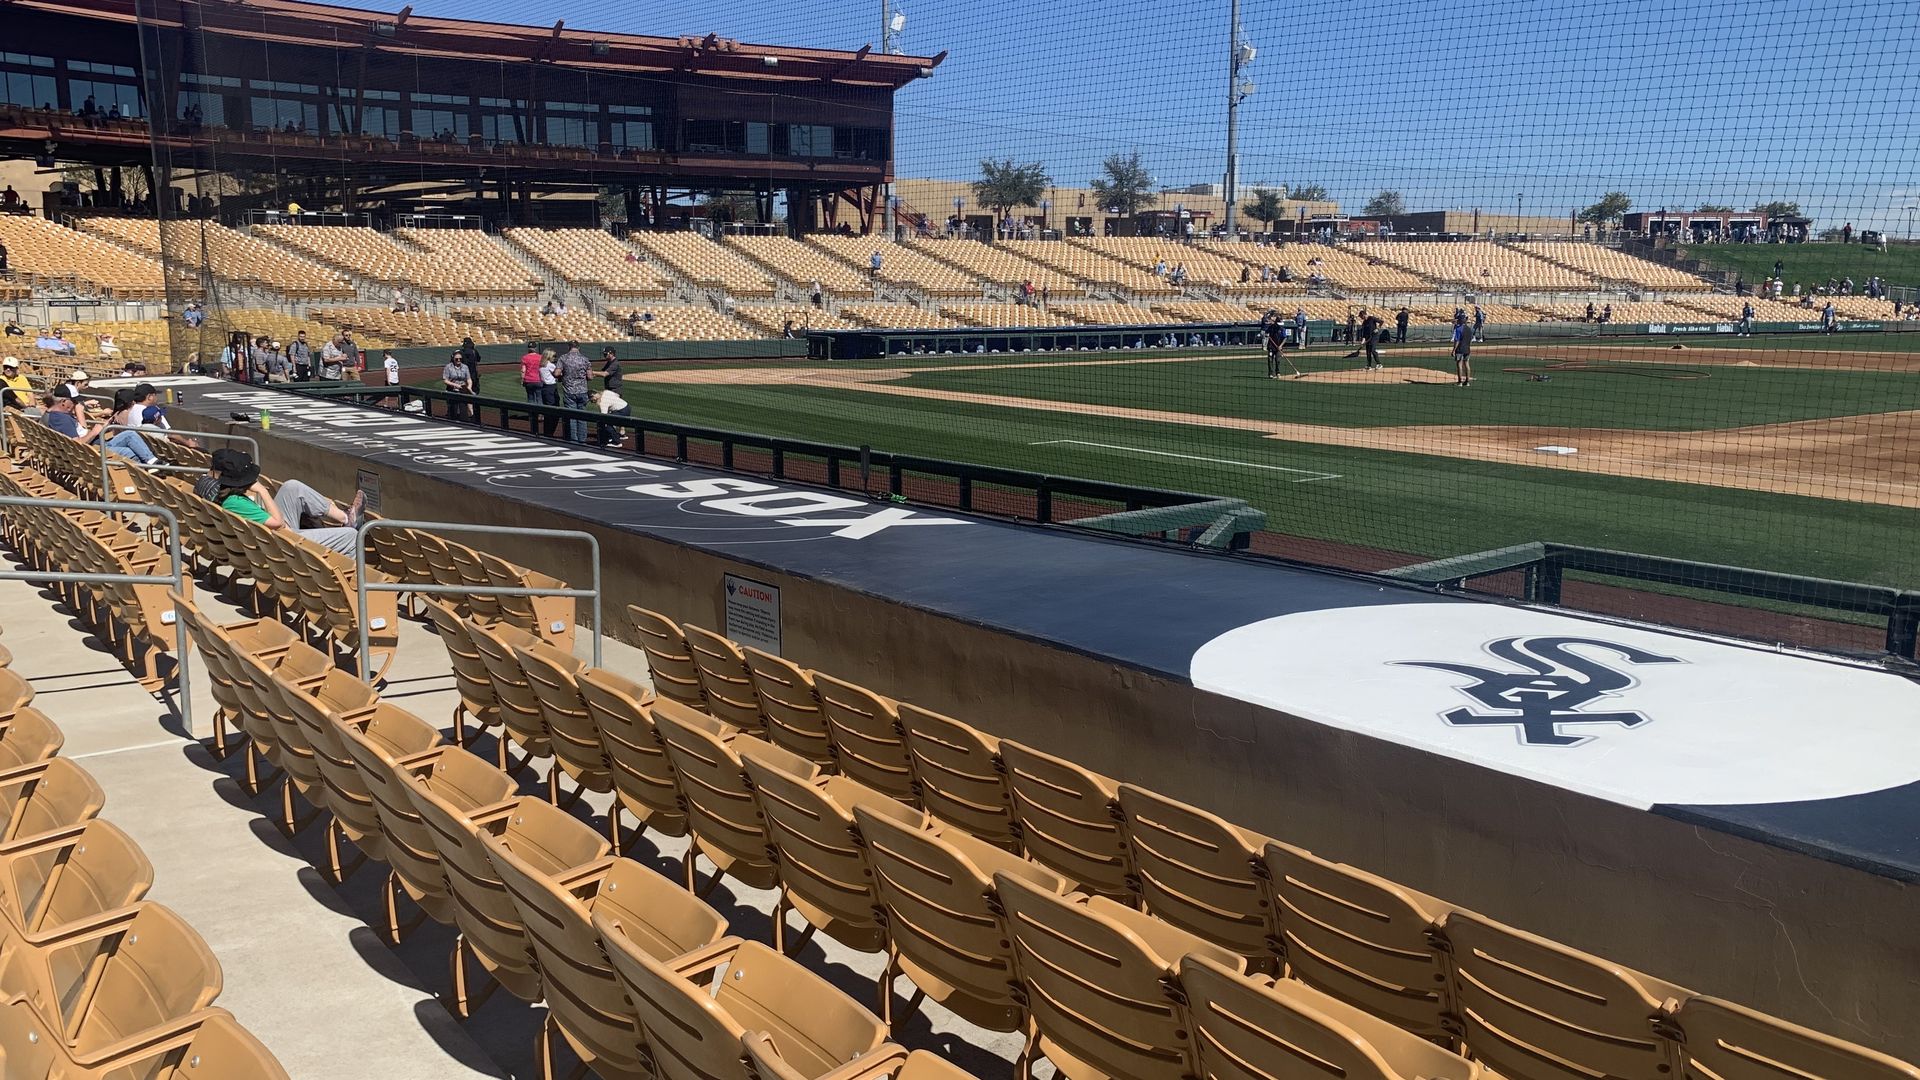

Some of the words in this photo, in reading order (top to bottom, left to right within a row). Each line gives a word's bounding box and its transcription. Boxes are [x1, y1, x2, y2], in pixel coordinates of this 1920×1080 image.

[202, 391, 427, 427] CHICAGO
[373, 426, 677, 479] WHITE
[625, 477, 978, 540] SOX
[387, 448, 532, 479] GLENDALE
[738, 585, 773, 603] CAUTION!
